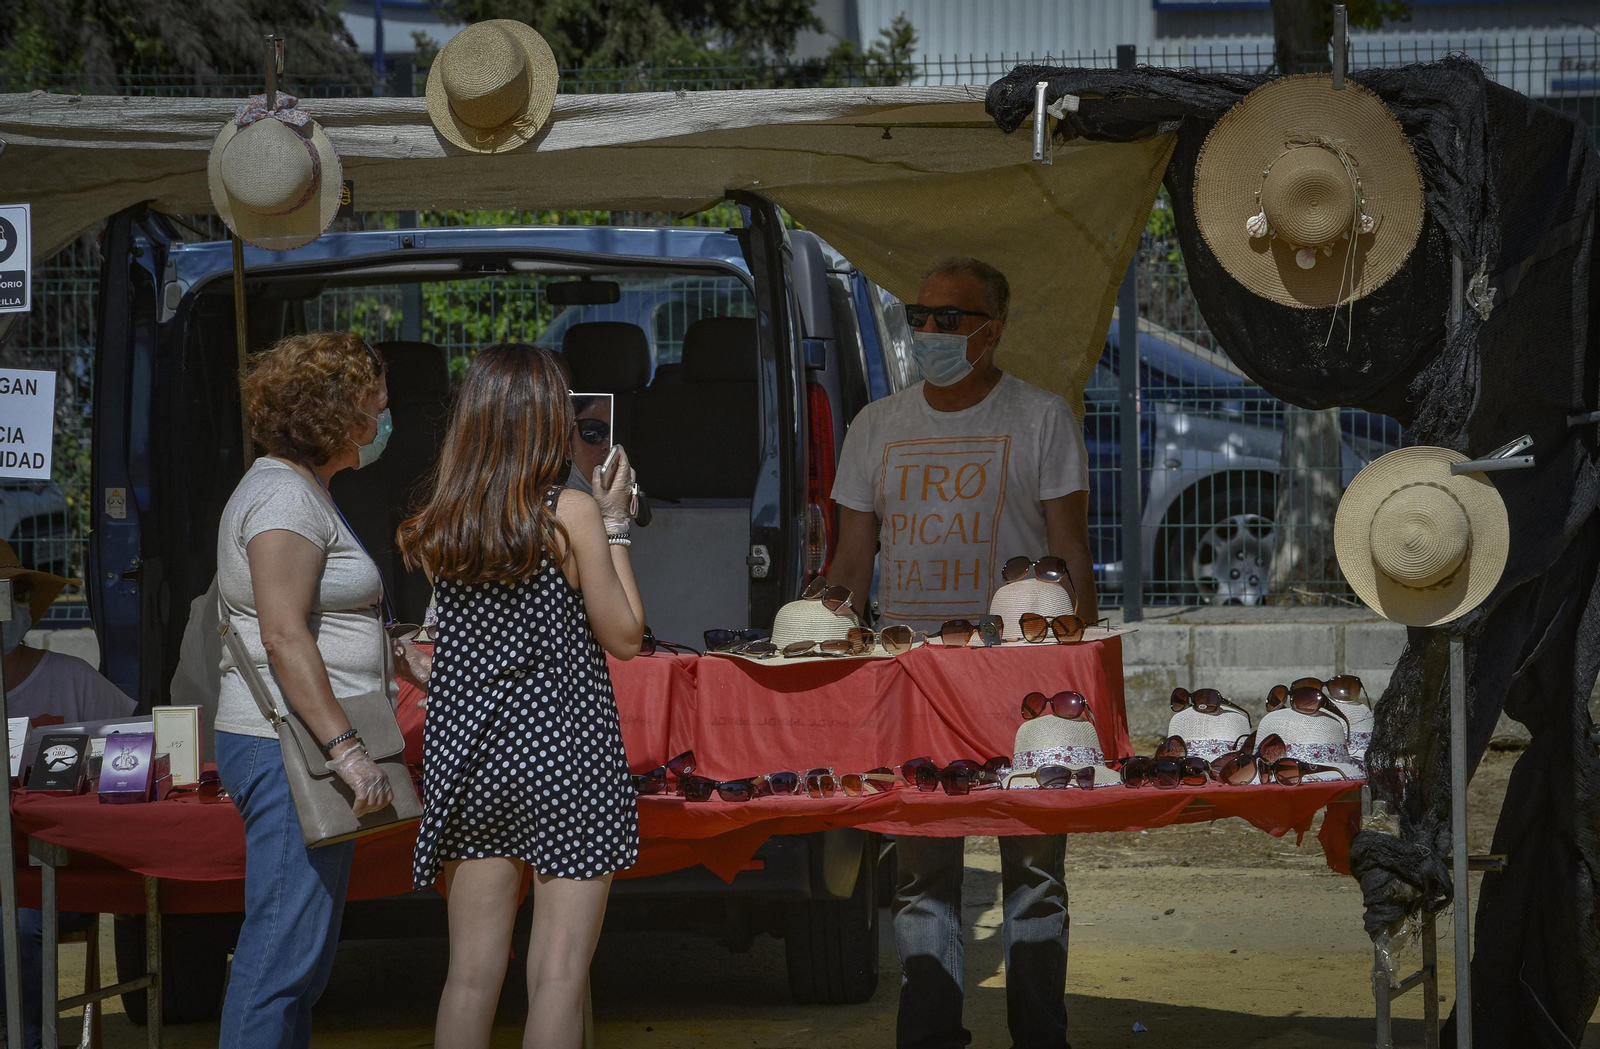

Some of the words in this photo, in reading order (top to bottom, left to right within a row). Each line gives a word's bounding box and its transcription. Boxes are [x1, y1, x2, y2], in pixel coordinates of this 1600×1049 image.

[0, 297, 21, 305] ILLA
[0, 377, 37, 396] GAN
[891, 512, 990, 545] PICAL
